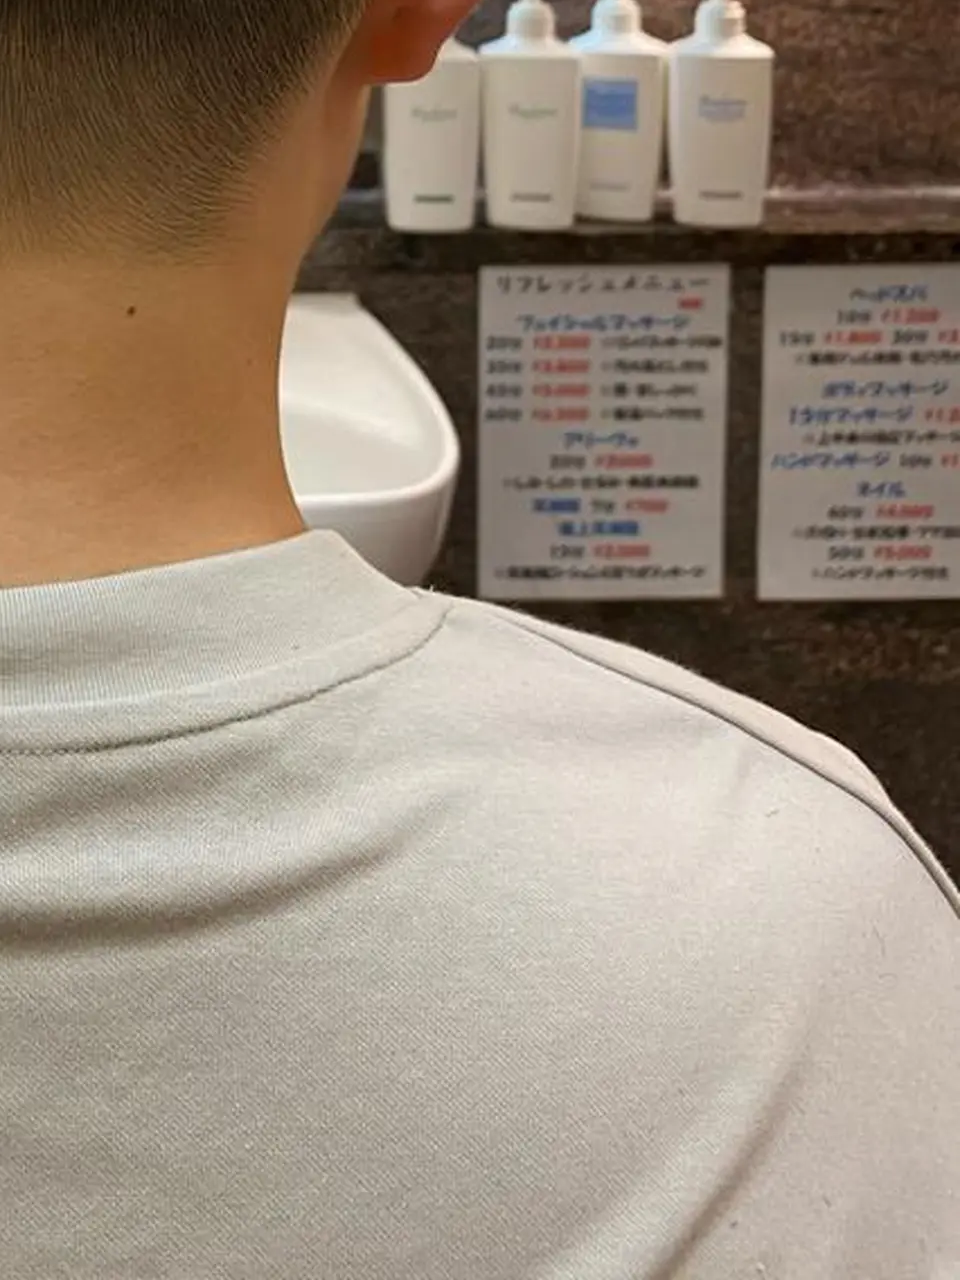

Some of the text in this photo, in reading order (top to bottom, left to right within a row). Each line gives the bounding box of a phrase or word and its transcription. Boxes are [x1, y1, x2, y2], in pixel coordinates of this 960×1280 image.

[496, 274, 710, 295] リフレッシュメニュー
